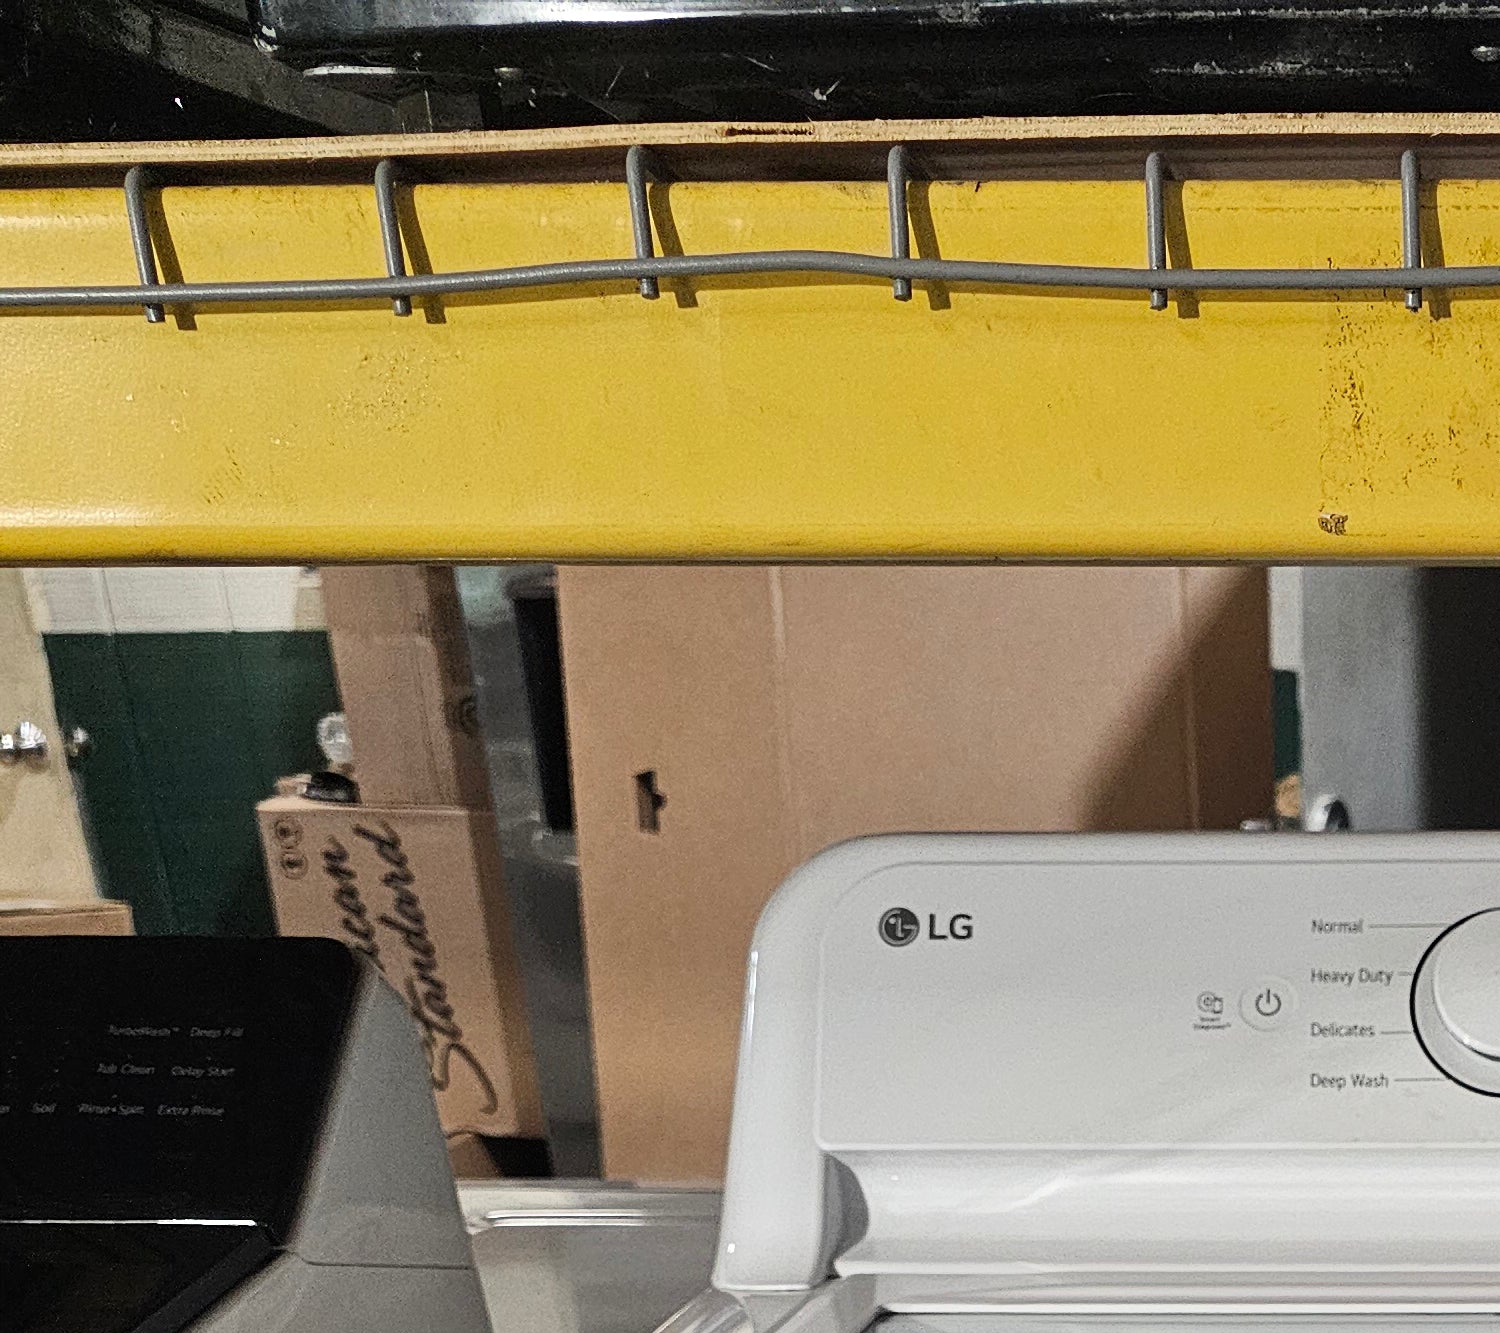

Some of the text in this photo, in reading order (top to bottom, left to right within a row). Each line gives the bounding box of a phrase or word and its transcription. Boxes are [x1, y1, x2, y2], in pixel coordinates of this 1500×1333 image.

[929, 913, 973, 940] LG
[1311, 918, 1364, 935] Normal
[1310, 966, 1393, 988] Heavy Duty
[1310, 1021, 1376, 1038] Delicates
[1310, 1072, 1389, 1091] Deep Wash
